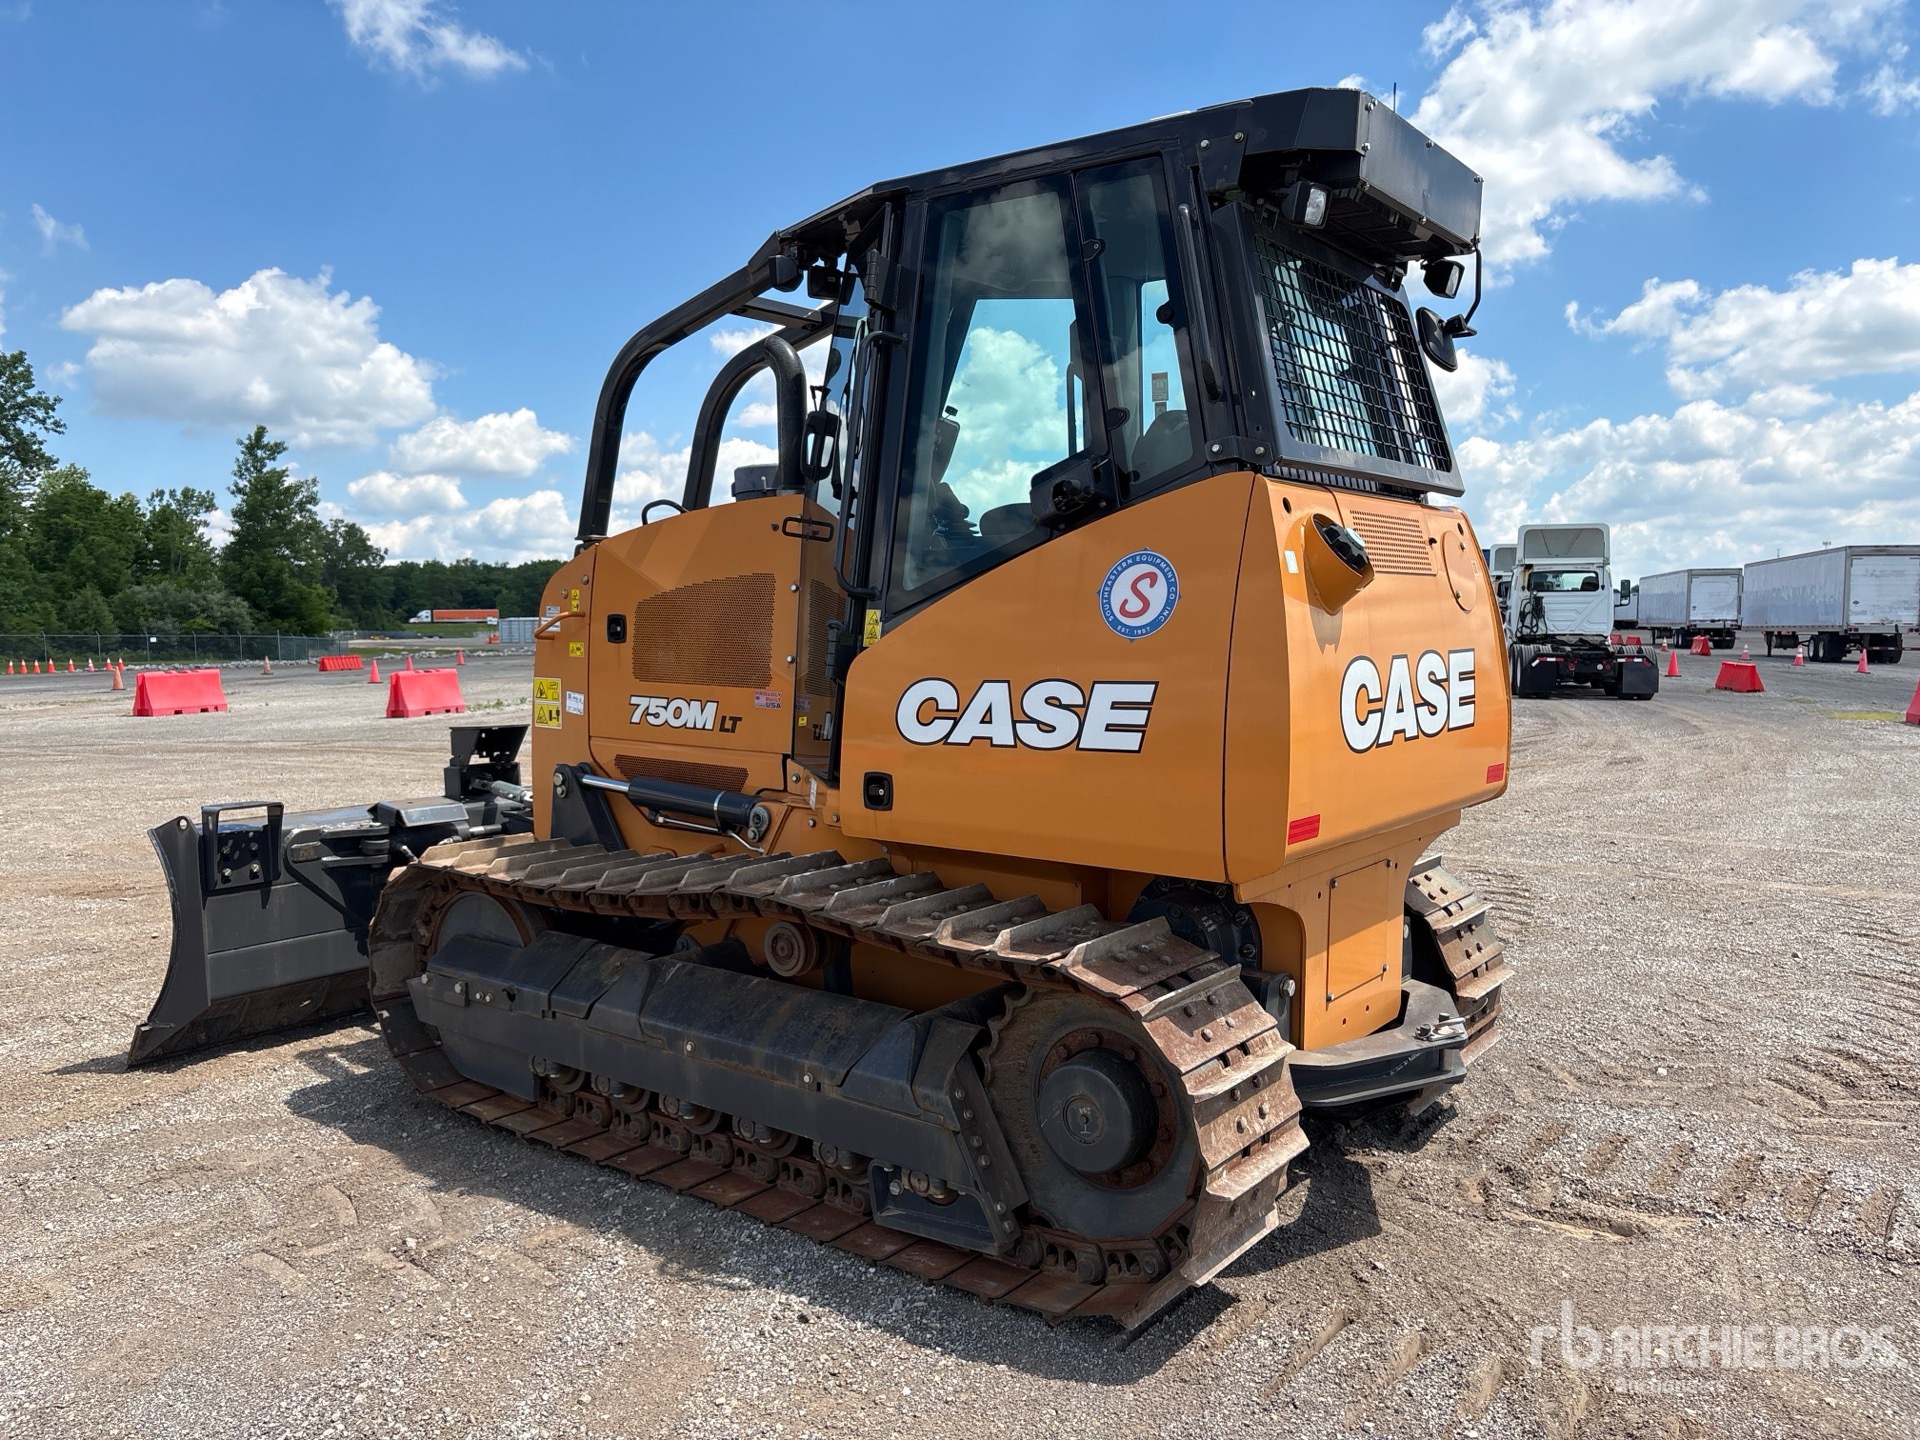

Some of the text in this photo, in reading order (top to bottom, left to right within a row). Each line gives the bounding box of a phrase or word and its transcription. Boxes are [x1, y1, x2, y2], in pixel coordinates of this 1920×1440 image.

[1103, 558, 1133, 622] SOUTHEASTERN
[1136, 554, 1175, 583] EQUIPMENT
[1119, 571, 1158, 618] S
[1134, 627, 1151, 635] 1957
[629, 694, 742, 733] 750M LT
[895, 677, 1159, 753] CASE
[1340, 648, 1475, 754] CASE
